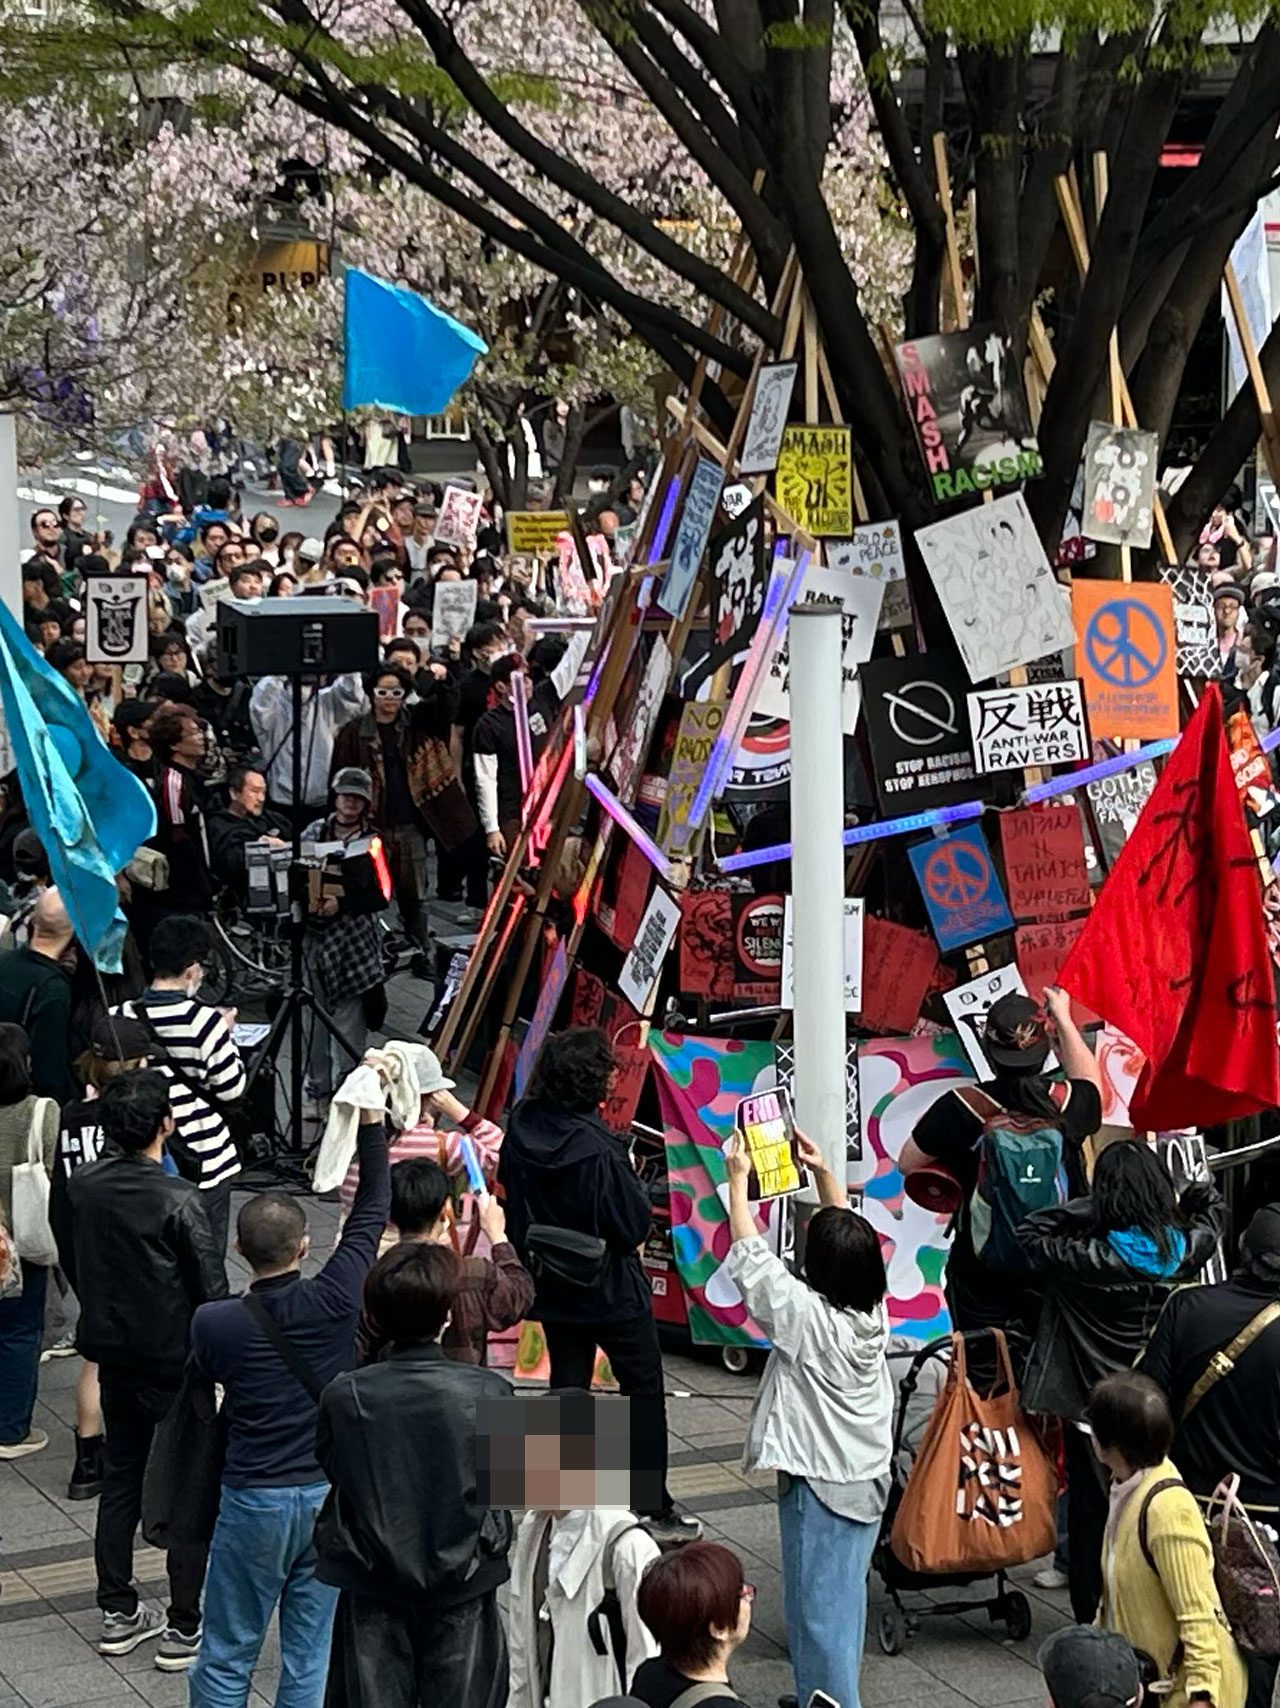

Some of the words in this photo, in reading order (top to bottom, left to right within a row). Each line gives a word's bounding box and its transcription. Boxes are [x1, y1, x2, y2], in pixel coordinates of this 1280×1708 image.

[902, 344, 949, 473] SMASH
[933, 450, 1043, 499] RACISM
[688, 707, 722, 730] NO
[976, 687, 1081, 740] 反戦
[991, 730, 1069, 751] ANTI-WAR
[895, 758, 924, 775] STOP
[989, 743, 1076, 768] RAVERS
[884, 775, 914, 793] STOP
[1086, 768, 1155, 801] GOTHS
